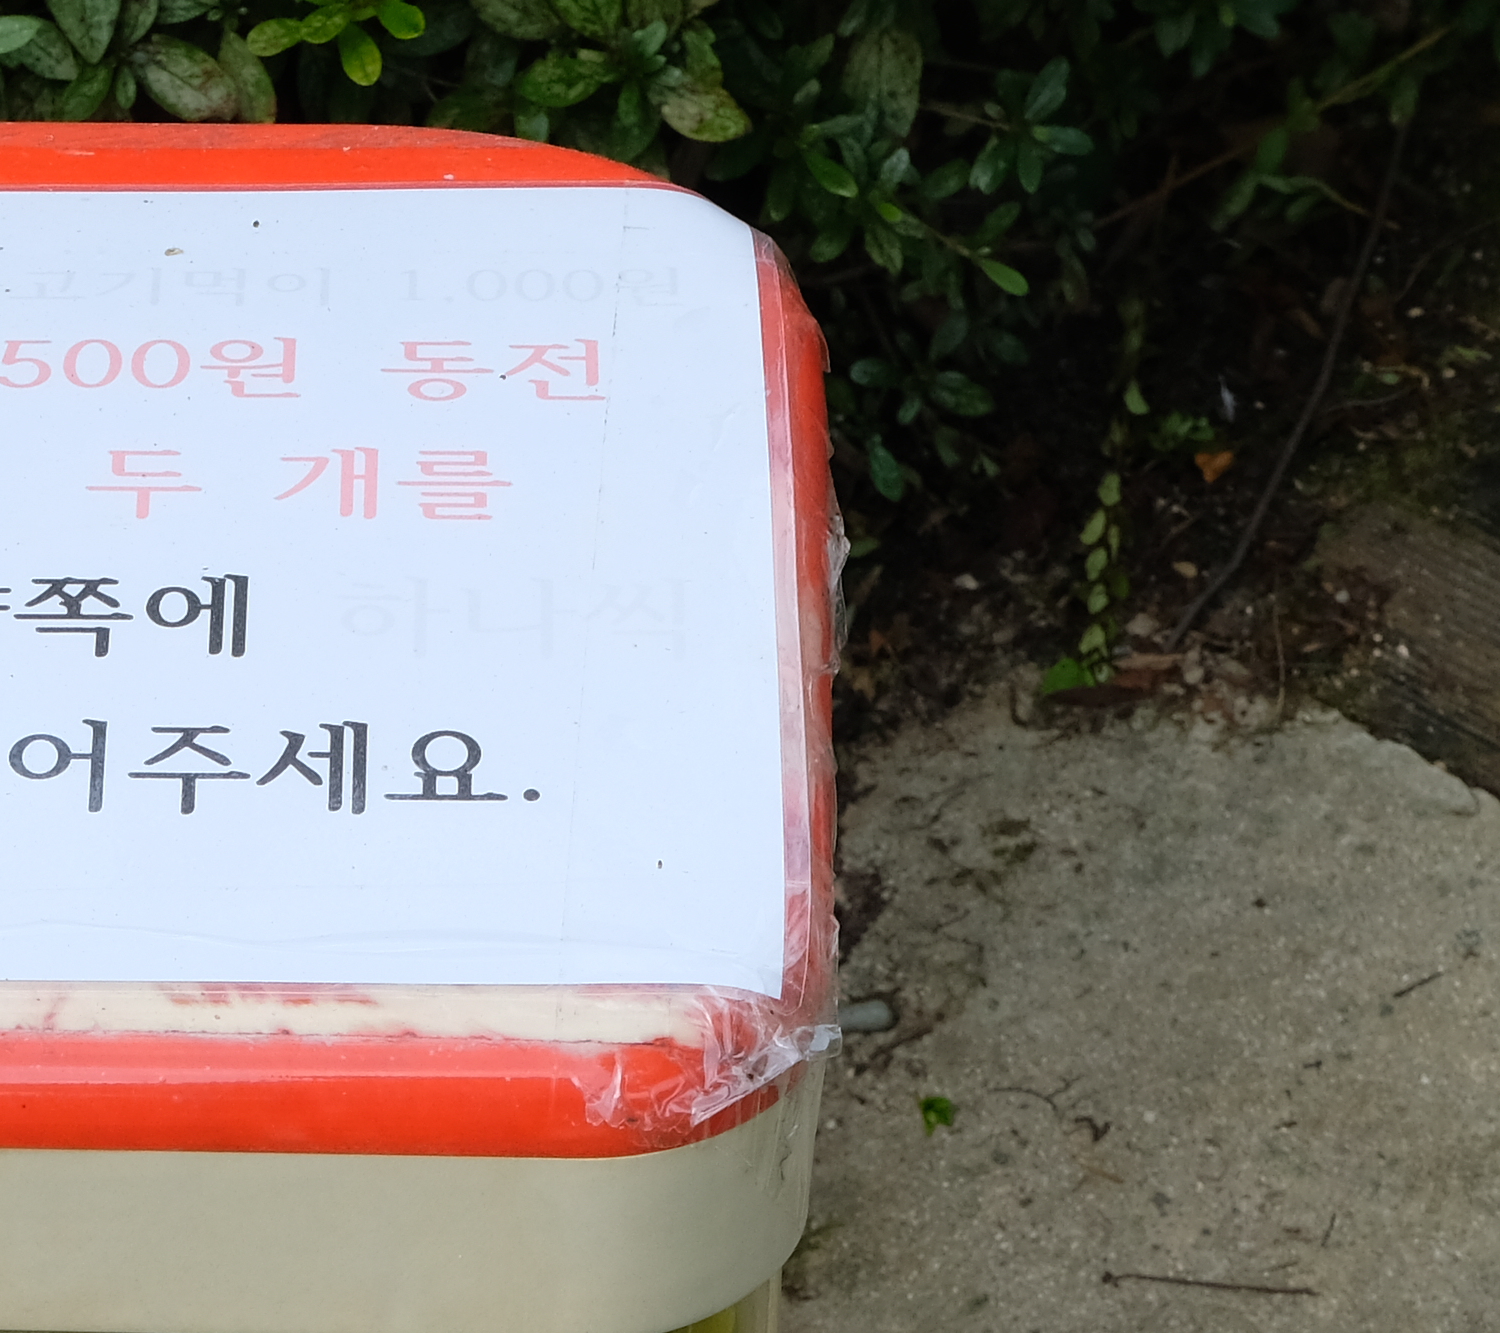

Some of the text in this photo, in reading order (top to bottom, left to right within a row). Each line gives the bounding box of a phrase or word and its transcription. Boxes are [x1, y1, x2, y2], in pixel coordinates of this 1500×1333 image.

[381, 339, 607, 401] 동전
[85, 446, 513, 521] 두 개를
[335, 574, 691, 662] 하나씩
